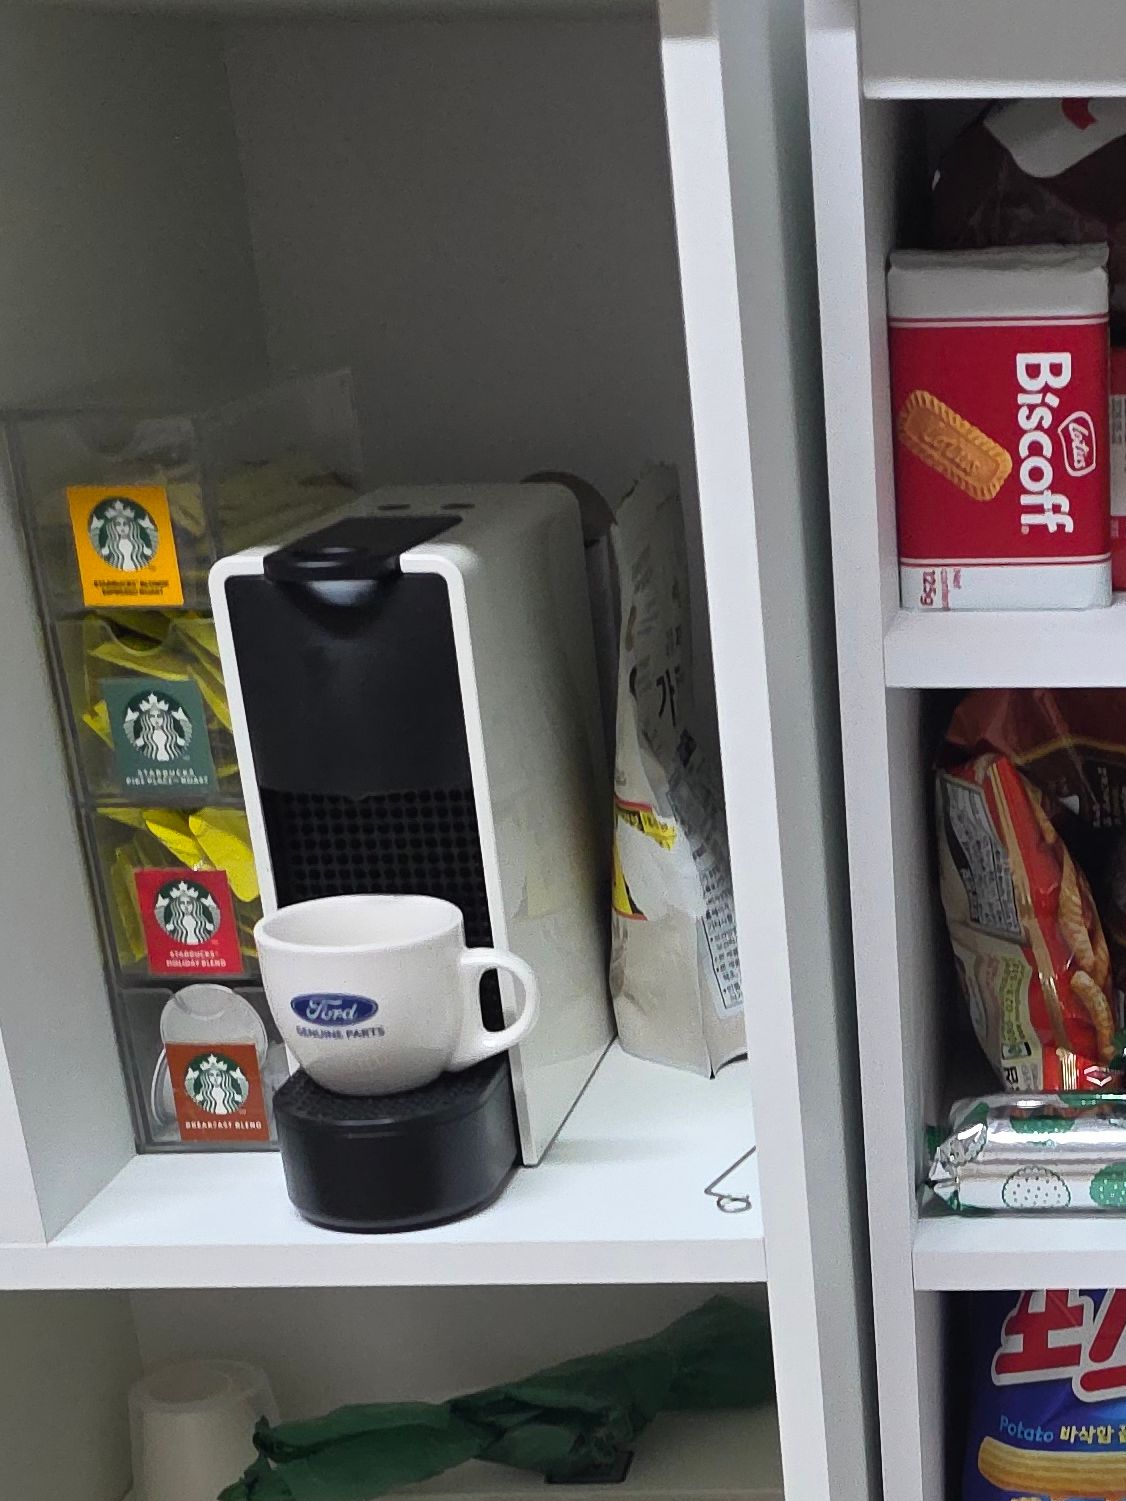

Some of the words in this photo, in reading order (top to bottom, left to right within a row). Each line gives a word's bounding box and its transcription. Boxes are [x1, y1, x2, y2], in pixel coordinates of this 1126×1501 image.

[1016, 352, 1075, 535] Biscoff
[1069, 422, 1090, 470] Lotus
[305, 998, 360, 1021] Ford
[295, 1026, 343, 1040] GENUINE
[345, 1025, 386, 1039] PARTS
[1000, 1413, 1054, 1443] Potato
